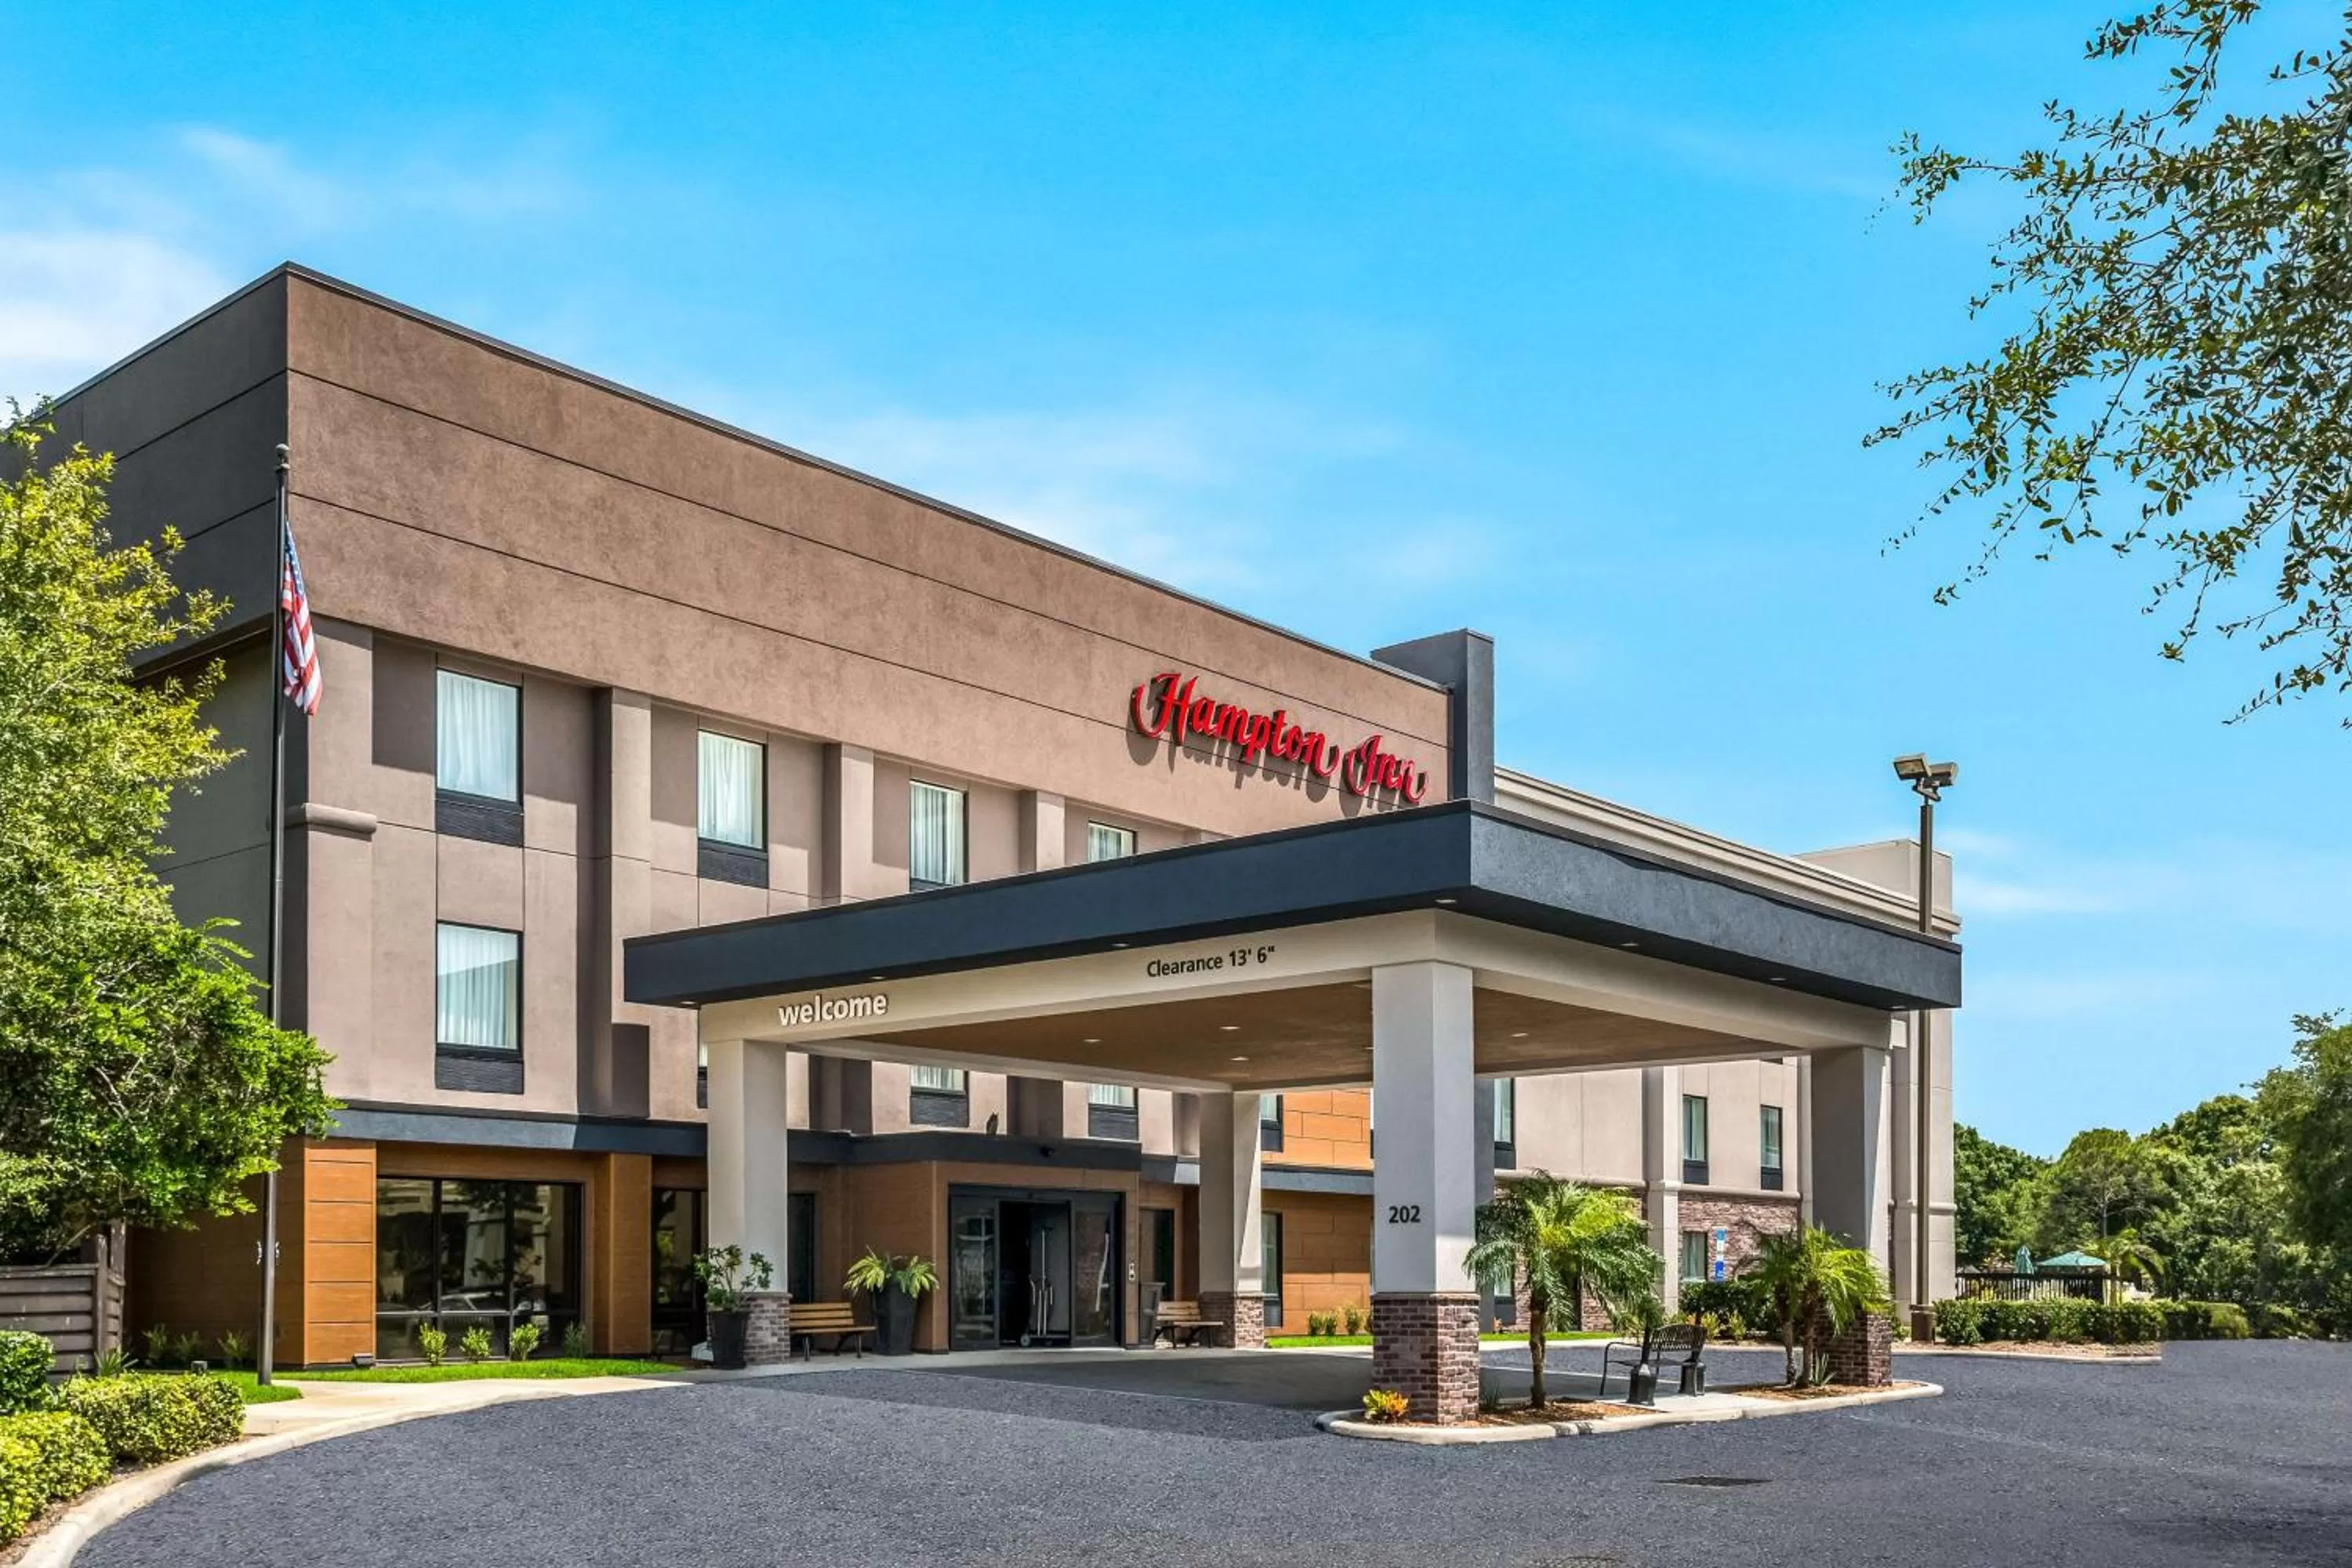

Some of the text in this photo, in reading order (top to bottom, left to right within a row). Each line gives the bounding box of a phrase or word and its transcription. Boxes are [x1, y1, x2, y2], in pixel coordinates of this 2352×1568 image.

[1131, 673, 1430, 804] Hampton Inn
[1147, 946, 1276, 978] Clearance 13' 6"
[779, 994, 888, 1026] welcome
[1388, 1205, 1421, 1224] 202
